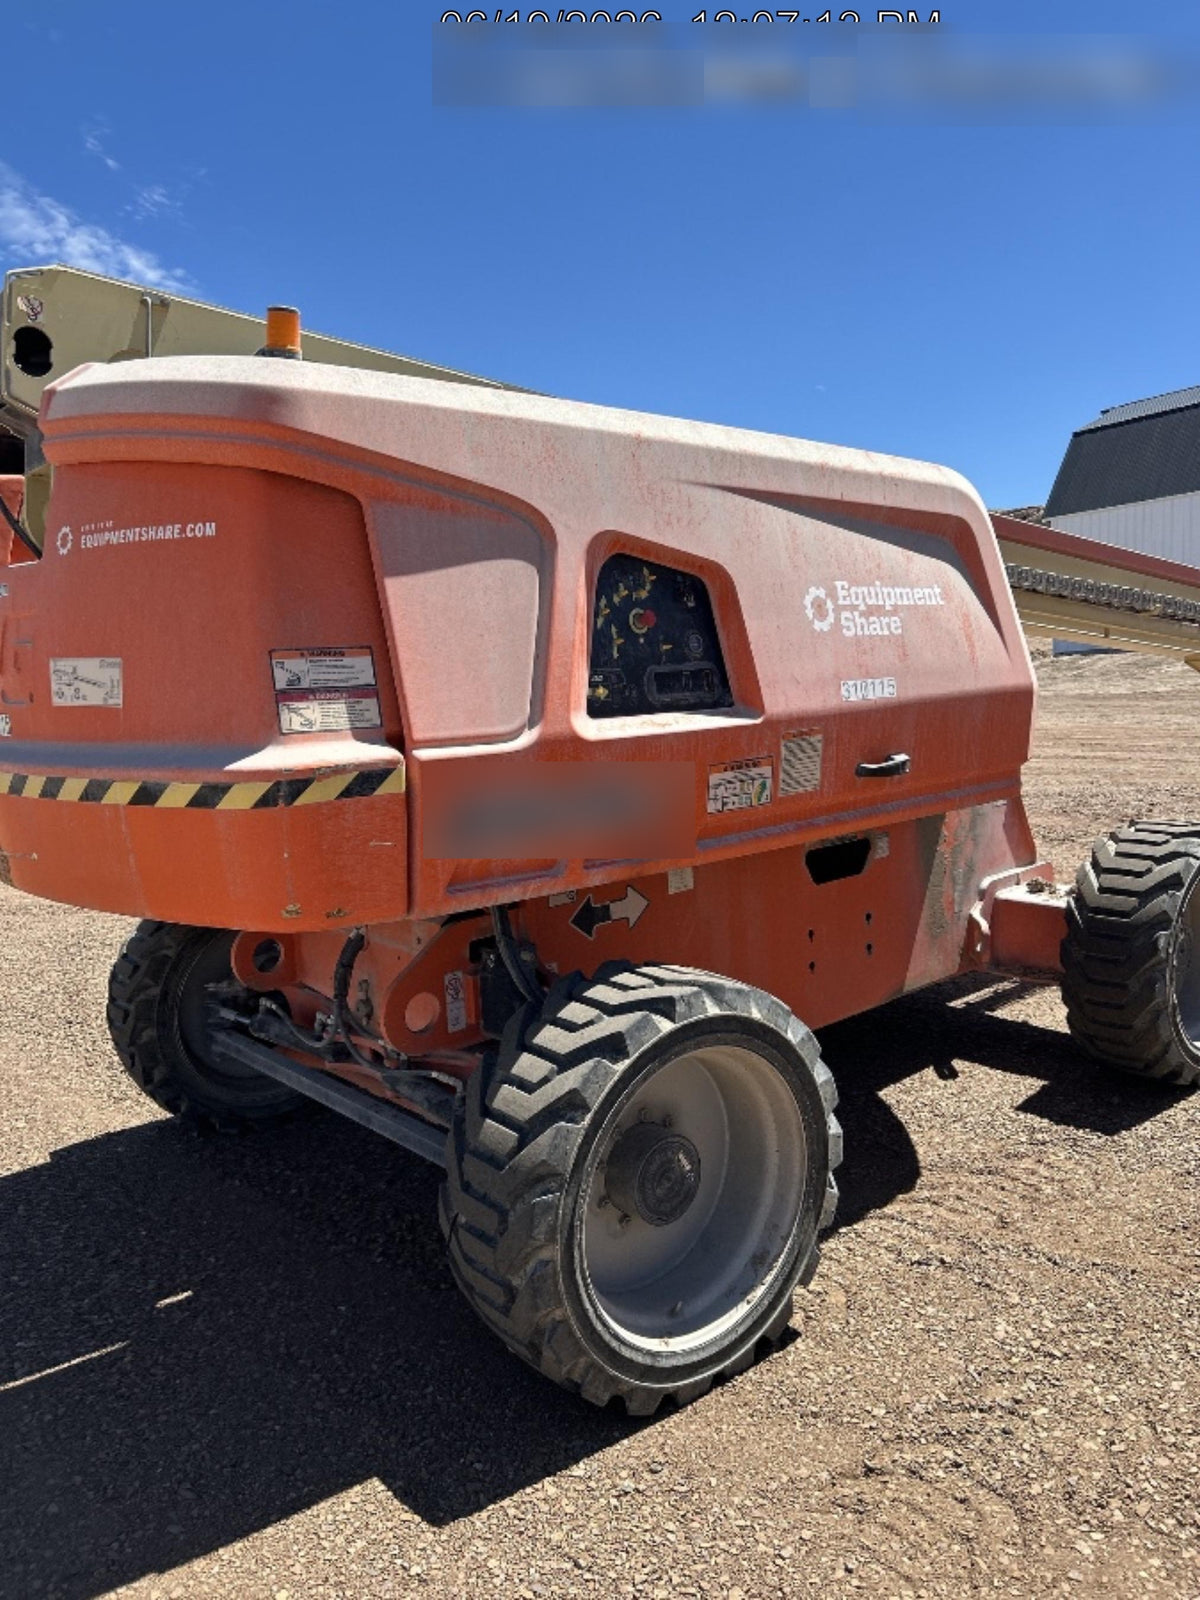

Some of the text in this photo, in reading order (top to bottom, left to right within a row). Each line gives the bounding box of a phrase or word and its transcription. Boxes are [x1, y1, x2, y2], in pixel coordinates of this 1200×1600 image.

[80, 522, 216, 548] EQUIPMENTSHARE.COM
[835, 581, 944, 610] Equipment
[840, 611, 902, 637] Share
[842, 678, 896, 700] 310115
